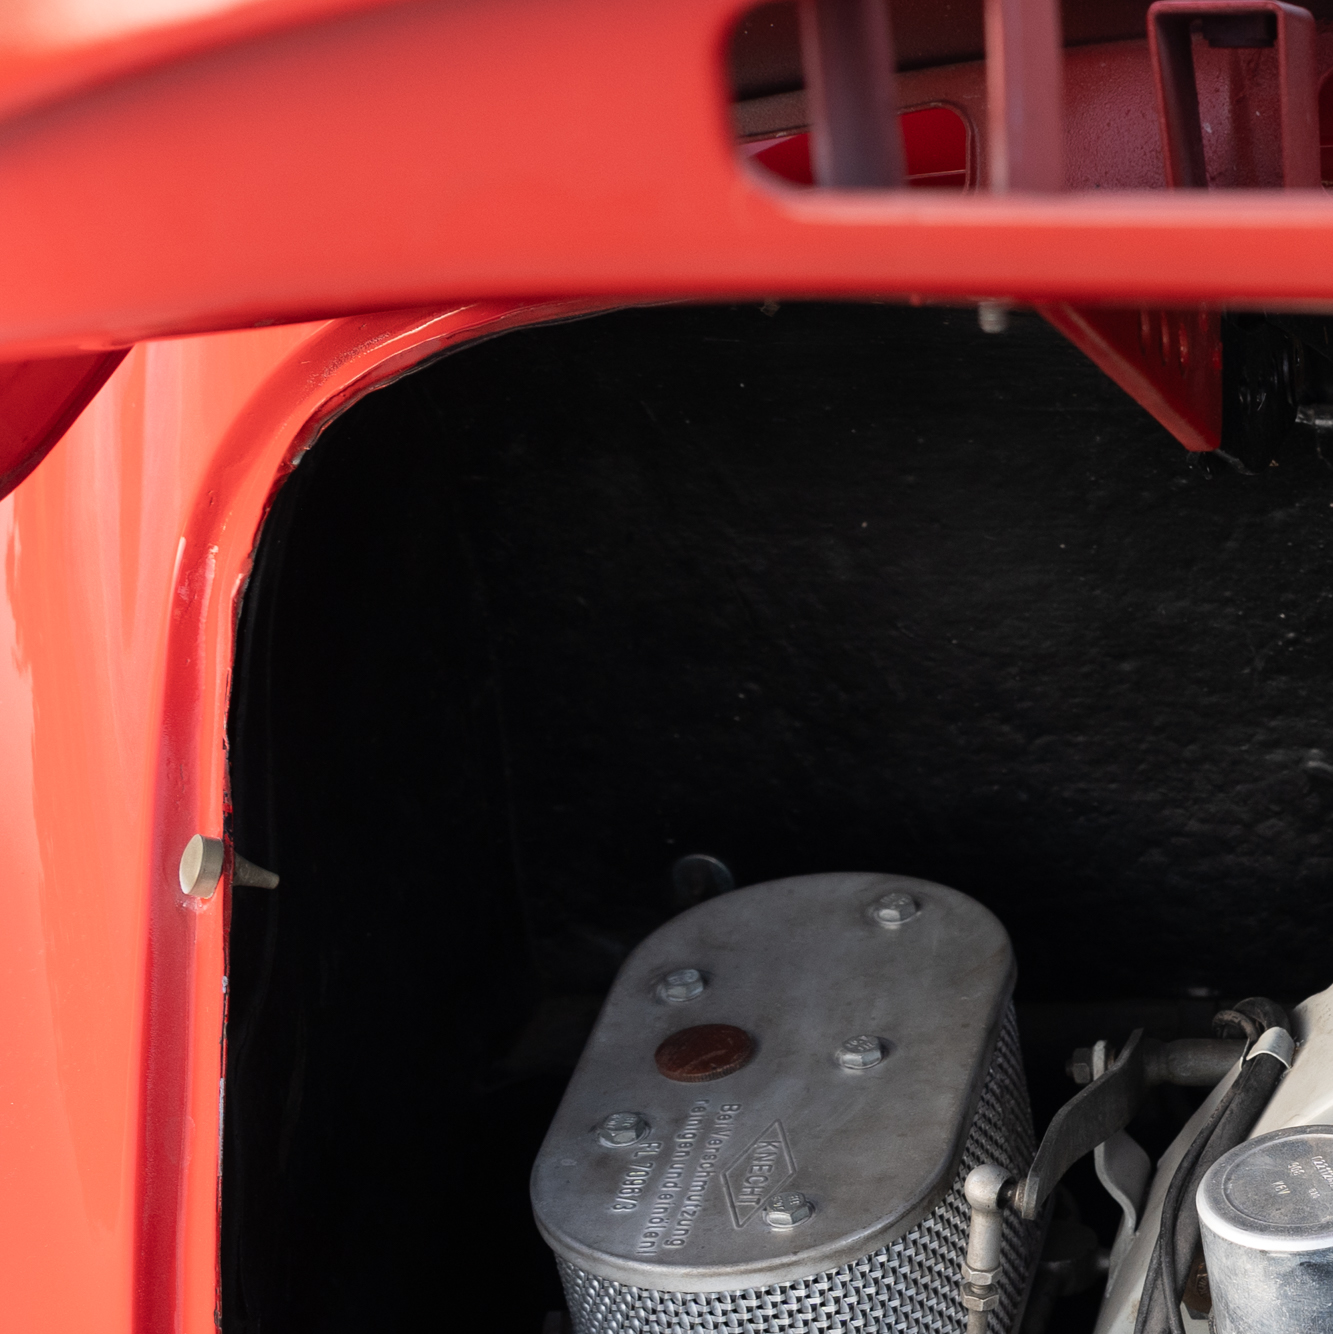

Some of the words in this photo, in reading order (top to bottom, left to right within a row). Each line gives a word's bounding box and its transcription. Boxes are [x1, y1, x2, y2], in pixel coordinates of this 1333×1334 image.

[714, 1103, 741, 1128] Bei
[633, 1141, 662, 1159] FL
[736, 1140, 782, 1206] KNECHT
[611, 1162, 654, 1212] 7096/3
[663, 1129, 733, 1249] Verschmutzung
